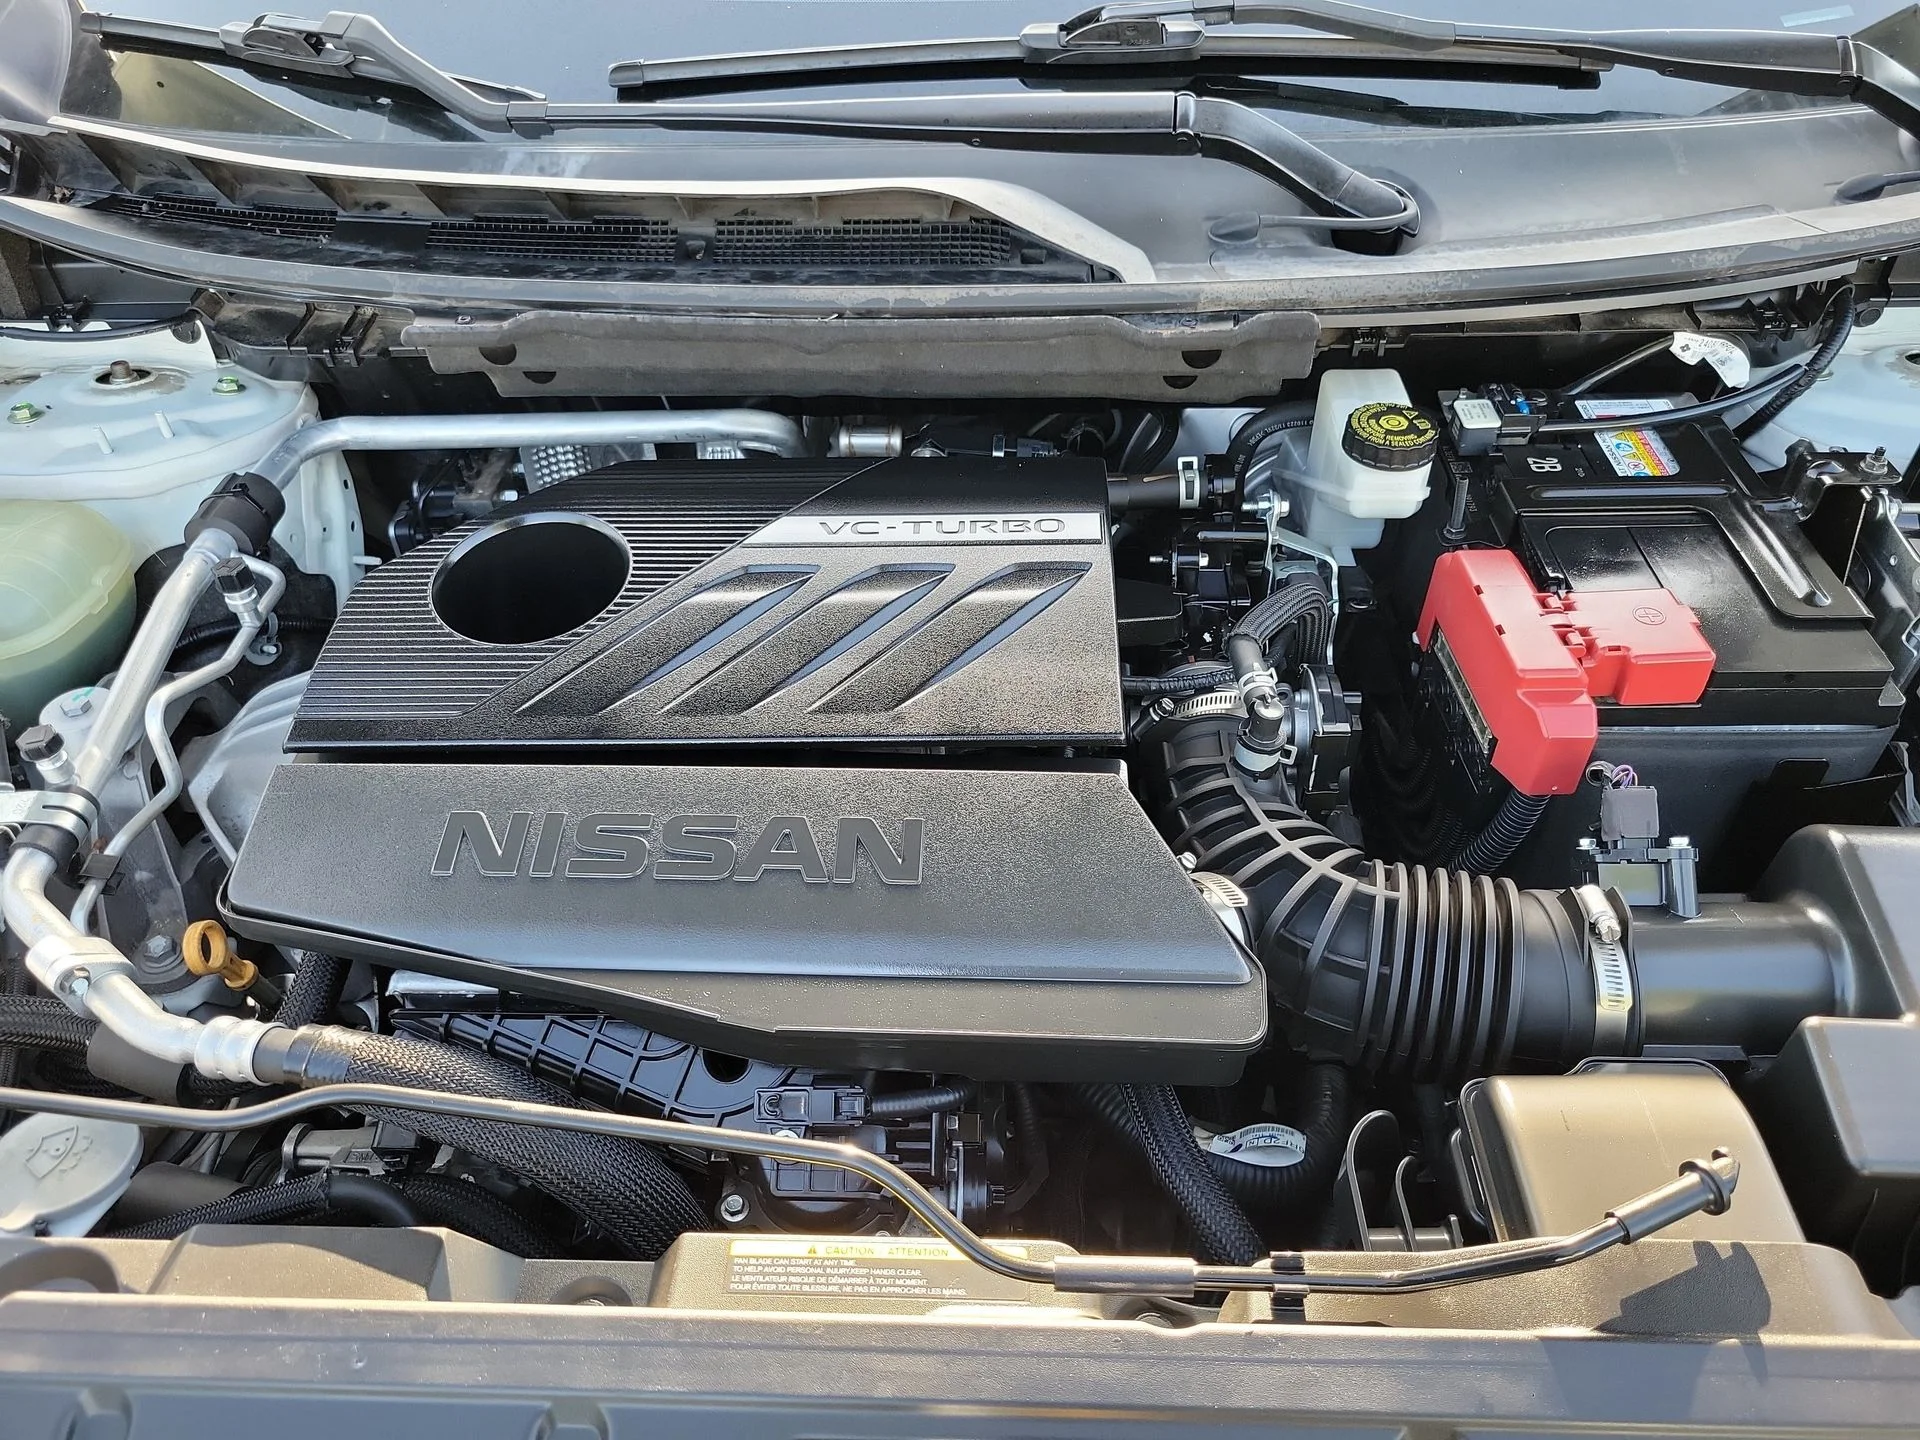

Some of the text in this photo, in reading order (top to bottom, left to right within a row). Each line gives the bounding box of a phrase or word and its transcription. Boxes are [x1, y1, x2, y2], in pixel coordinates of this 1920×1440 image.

[1527, 457, 1563, 472] 2B
[819, 518, 1066, 536] VC-TURBO
[431, 811, 925, 885] NISSAN
[825, 1246, 949, 1256] CAUTION ATTENTION
[875, 1277, 895, 1285] TOUT
[881, 1286, 927, 1294] APPROCHER
